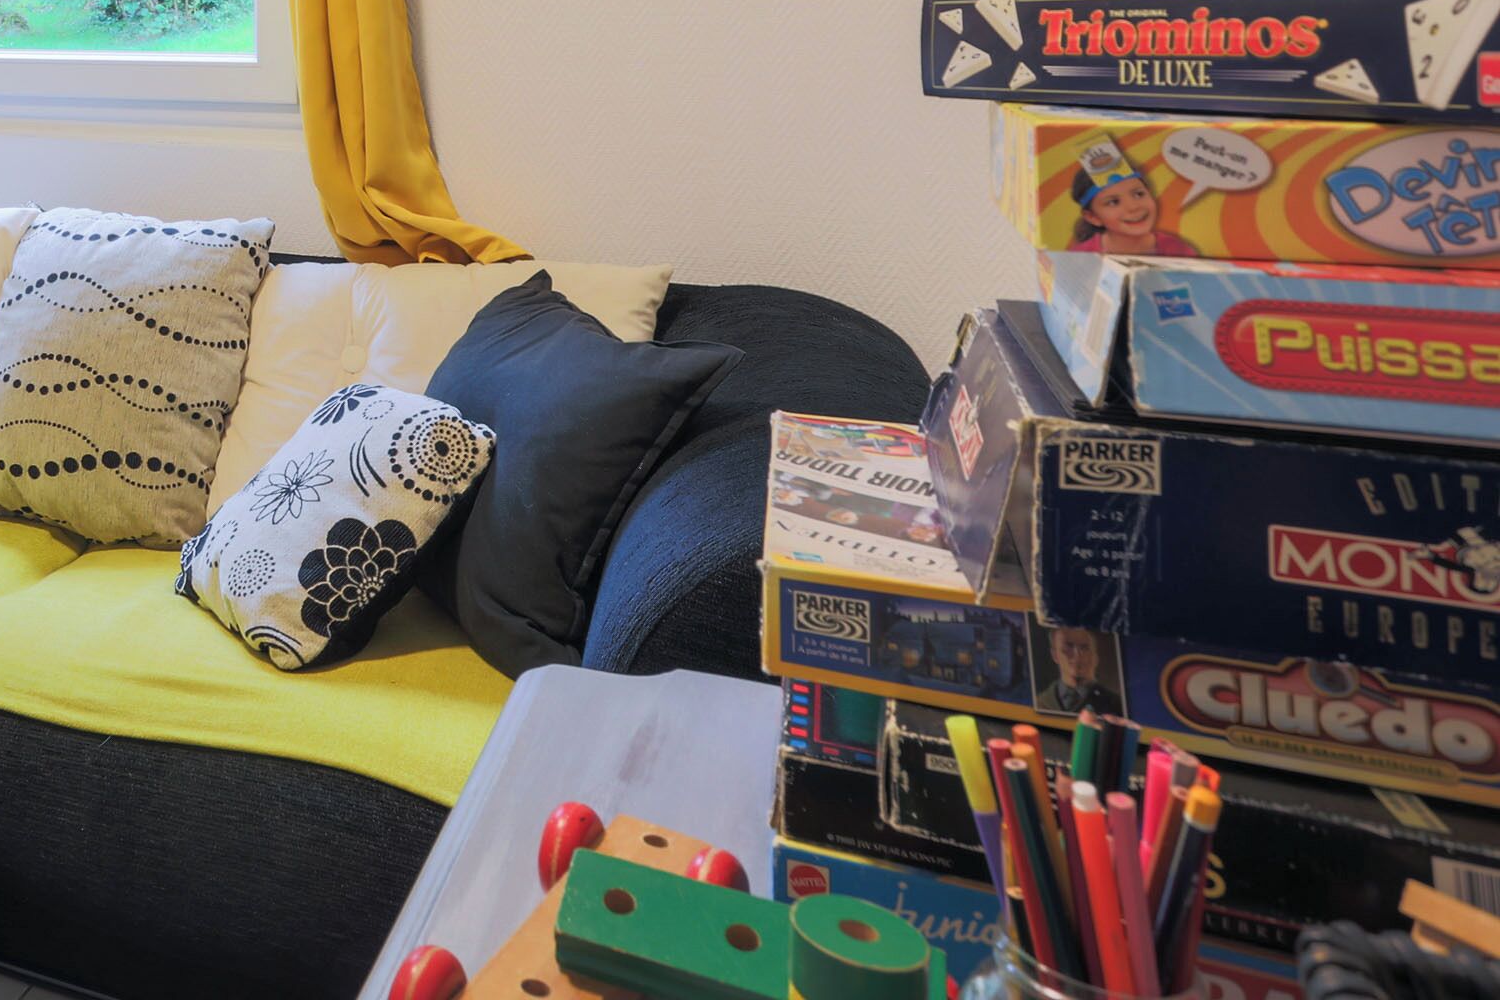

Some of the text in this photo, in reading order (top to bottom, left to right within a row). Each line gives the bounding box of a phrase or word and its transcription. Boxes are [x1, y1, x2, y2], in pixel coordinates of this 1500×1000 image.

[1127, 9, 1168, 17] ORIGINAL
[1039, 6, 1321, 58] Triominos
[1119, 60, 1213, 88] DE LUXE
[1169, 146, 1189, 159] me
[1192, 153, 1244, 181] manger
[1193, 136, 1248, 166] Peut-on
[775, 451, 863, 481] TUDOR
[1065, 441, 1155, 462] PARKER
[796, 593, 867, 618] PARKER
[1306, 595, 1498, 660] EUROPE
[1186, 668, 1493, 764] Cluedo
[793, 876, 828, 888] MATTEL
